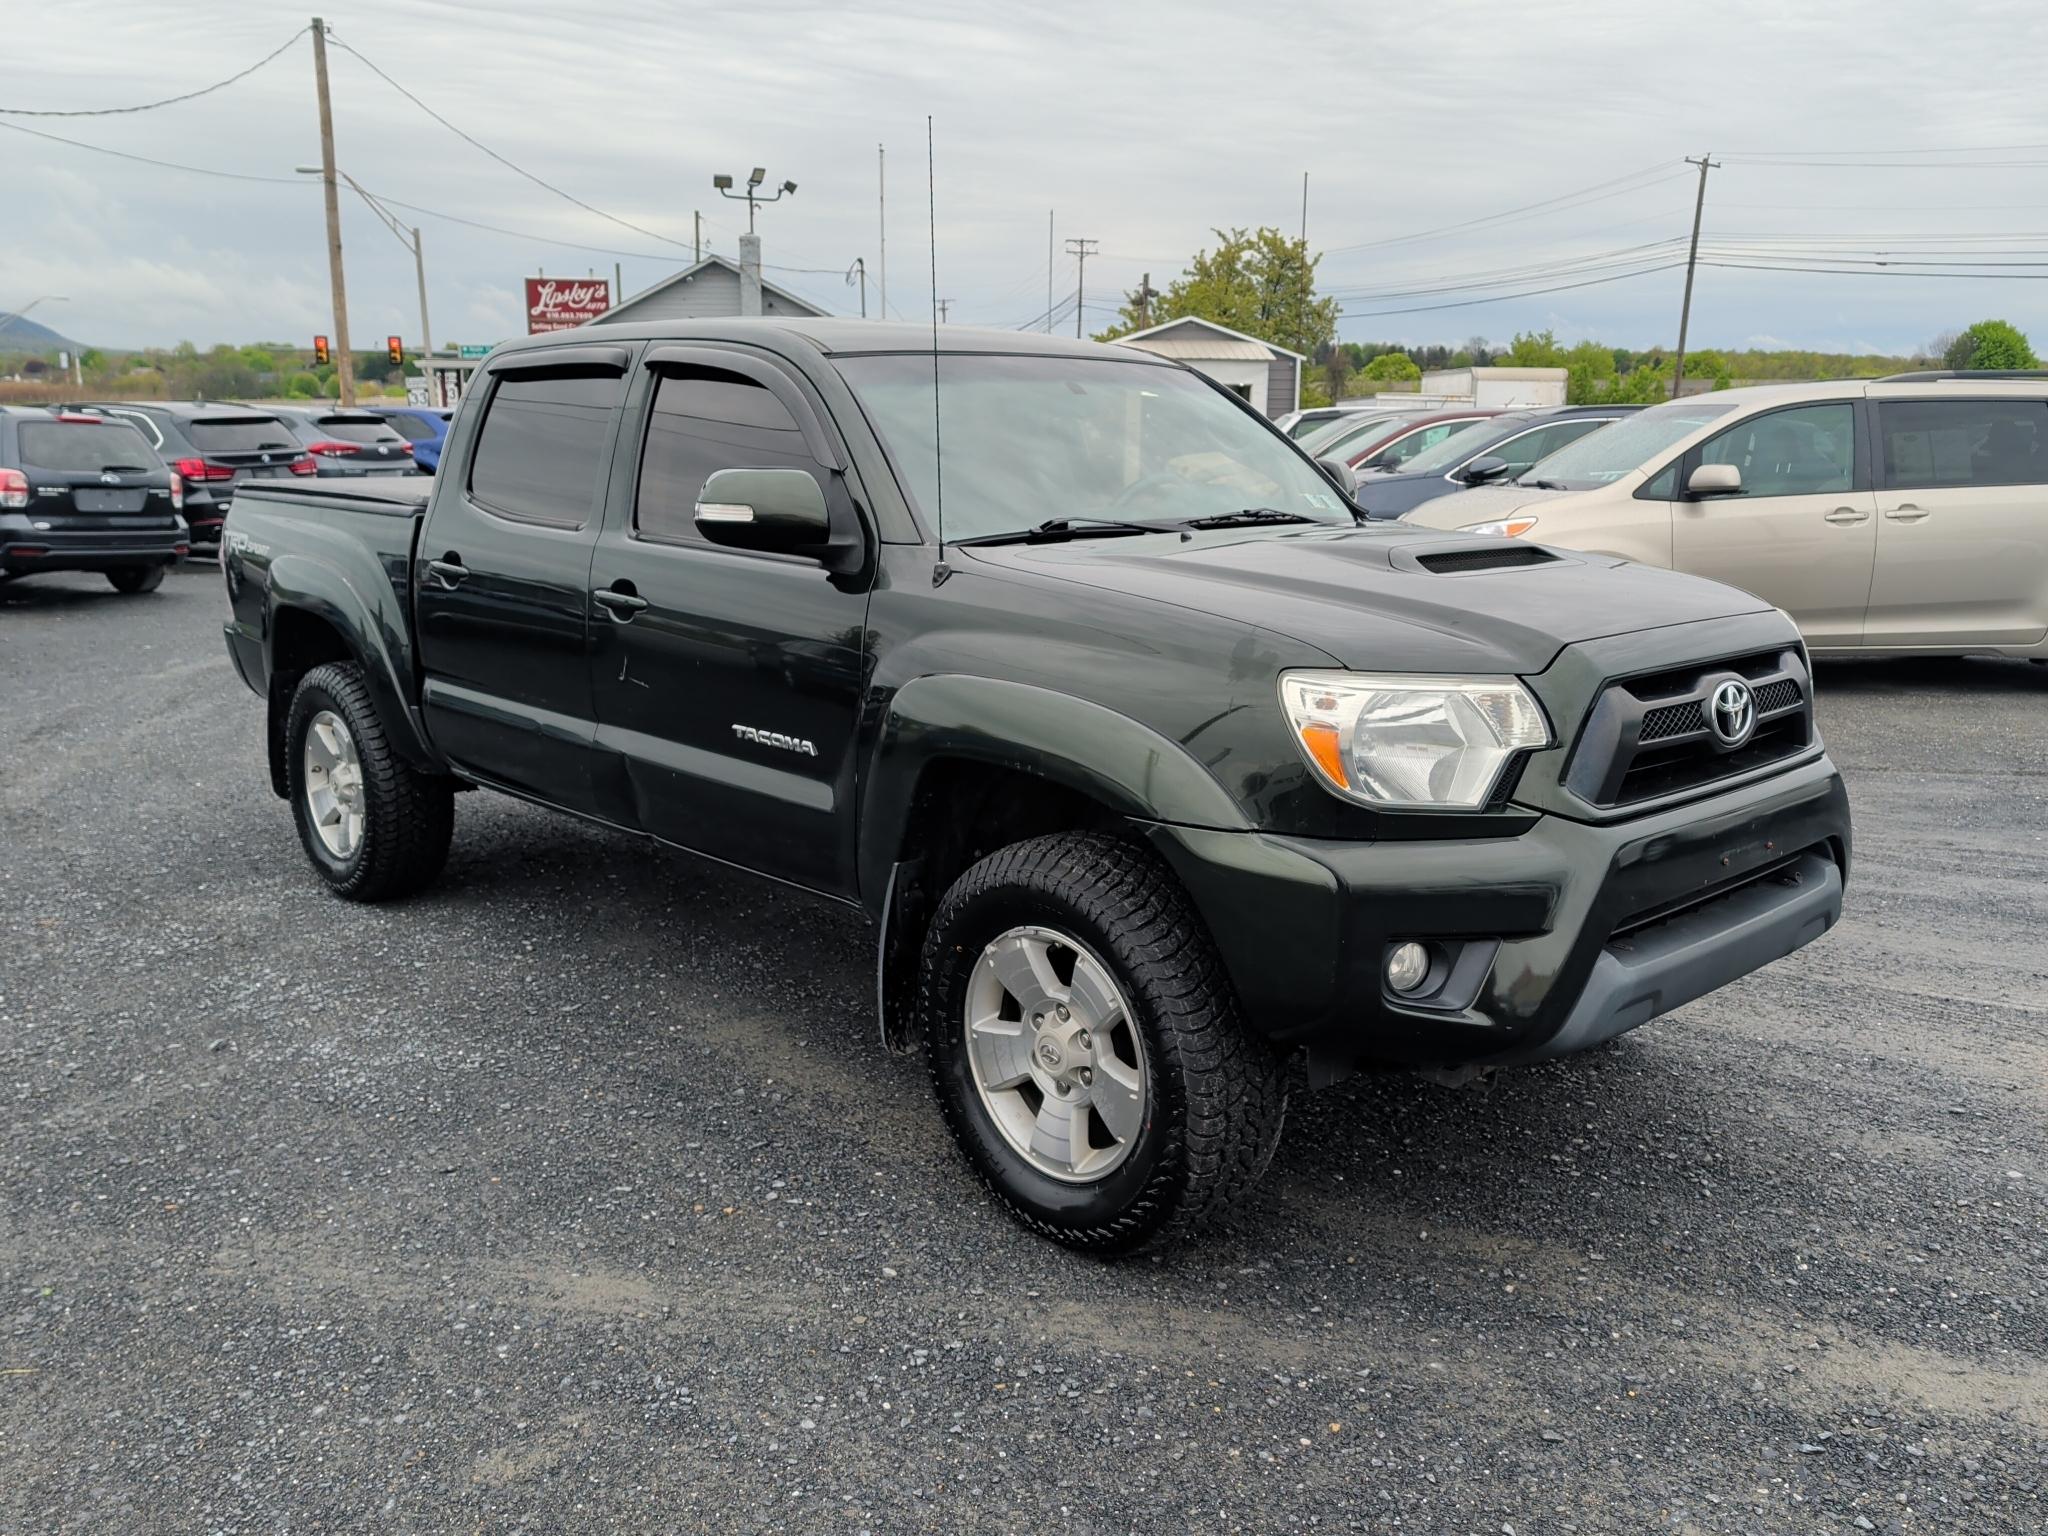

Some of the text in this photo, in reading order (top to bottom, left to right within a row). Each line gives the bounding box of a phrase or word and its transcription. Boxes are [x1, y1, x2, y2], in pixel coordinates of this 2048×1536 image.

[530, 281, 607, 316] Lipsky's
[586, 302, 607, 310] AUTO
[224, 530, 248, 555] TRD
[731, 723, 818, 757] TACOMA
